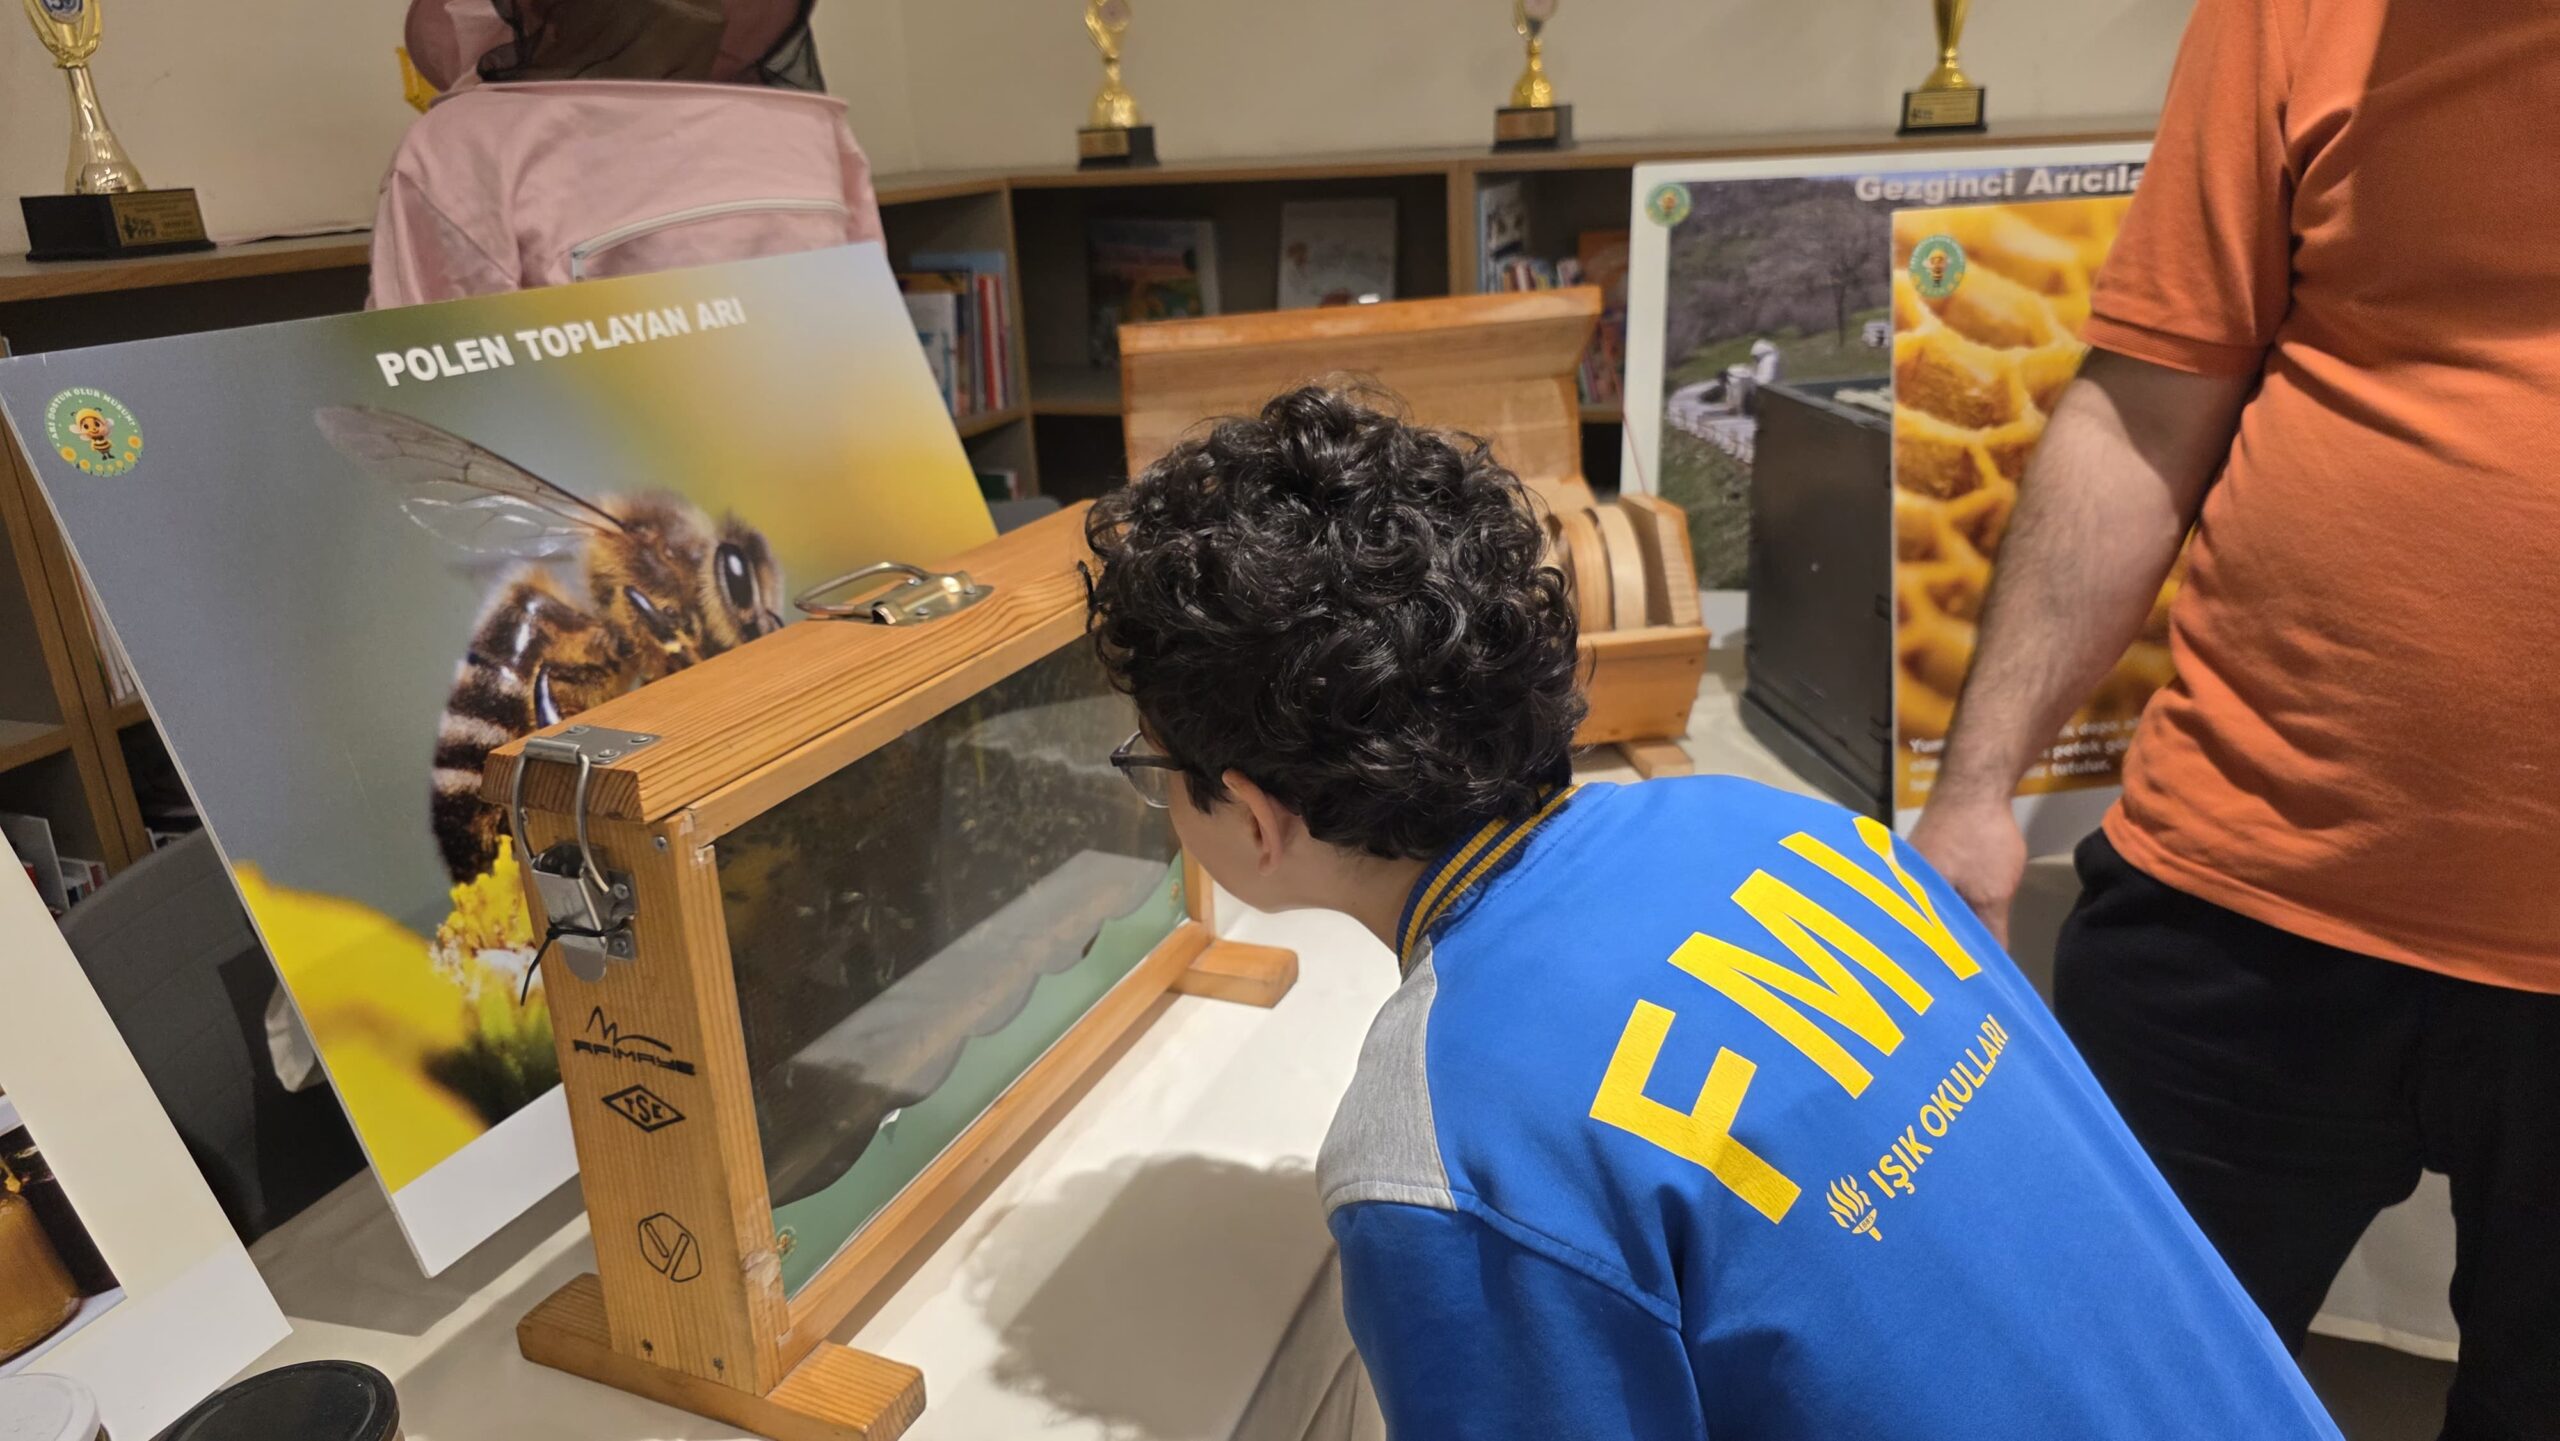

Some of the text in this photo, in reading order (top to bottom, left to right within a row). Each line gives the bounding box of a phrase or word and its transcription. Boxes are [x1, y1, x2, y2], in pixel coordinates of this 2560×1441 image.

[1855, 171, 2014, 204] Gezginci
[376, 297, 747, 387] POLEN TOPLAYAN ARI
[624, 1094, 663, 1123] TSE
[1868, 1013, 2009, 1199] IŞIK OKULLARI
